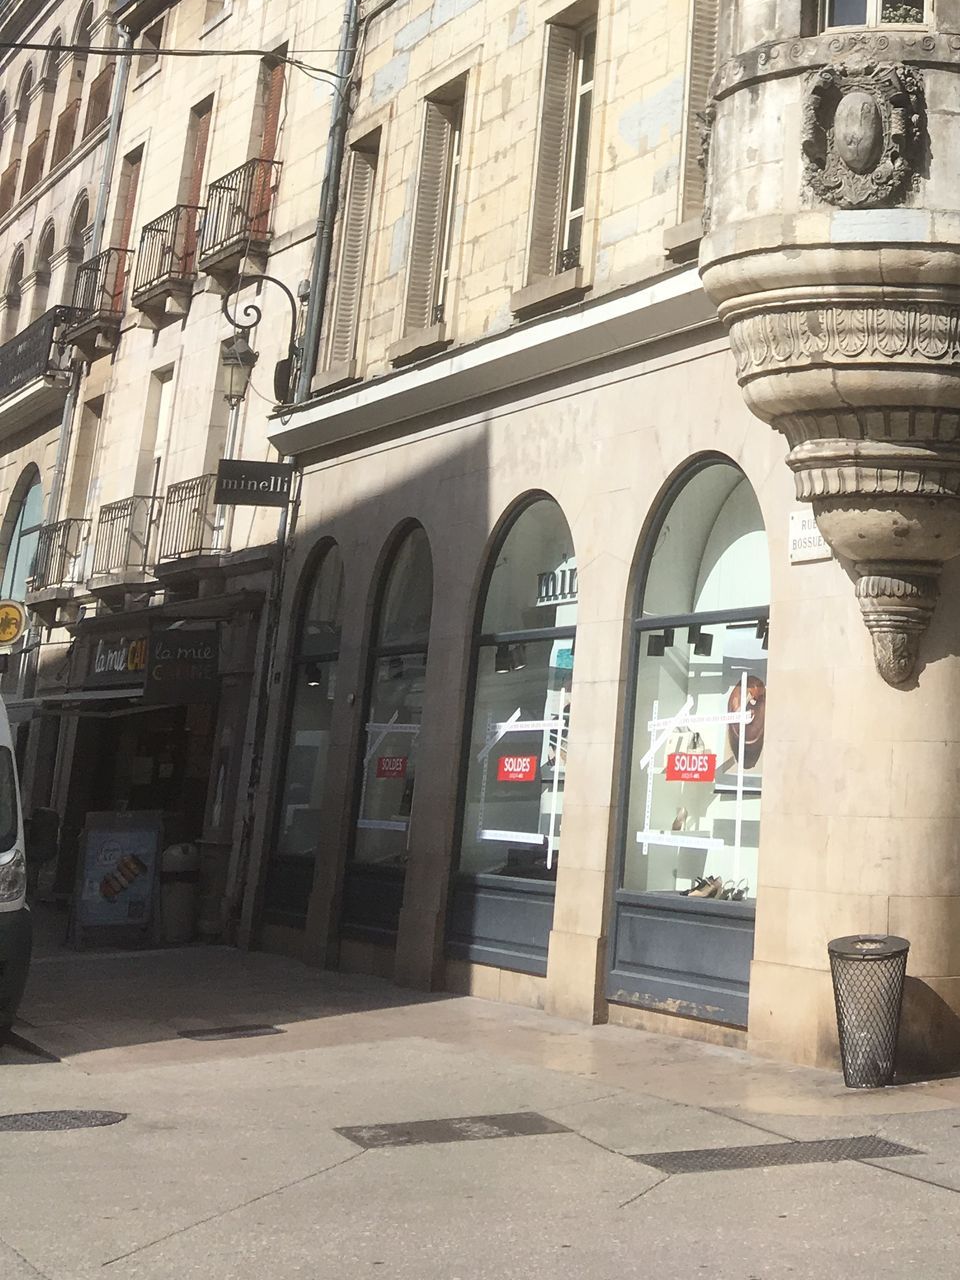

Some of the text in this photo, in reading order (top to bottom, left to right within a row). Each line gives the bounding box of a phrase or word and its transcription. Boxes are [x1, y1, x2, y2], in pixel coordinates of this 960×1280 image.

[222, 475, 288, 493] minelli
[801, 519, 817, 531] RUE
[792, 535, 825, 551] BOSSUE
[95, 639, 105, 673] la
[105, 636, 128, 672] mie
[177, 641, 216, 660] mie
[382, 758, 403, 771] SOLDES
[503, 757, 531, 772] SOLDES
[675, 754, 708, 772] SOLDES
